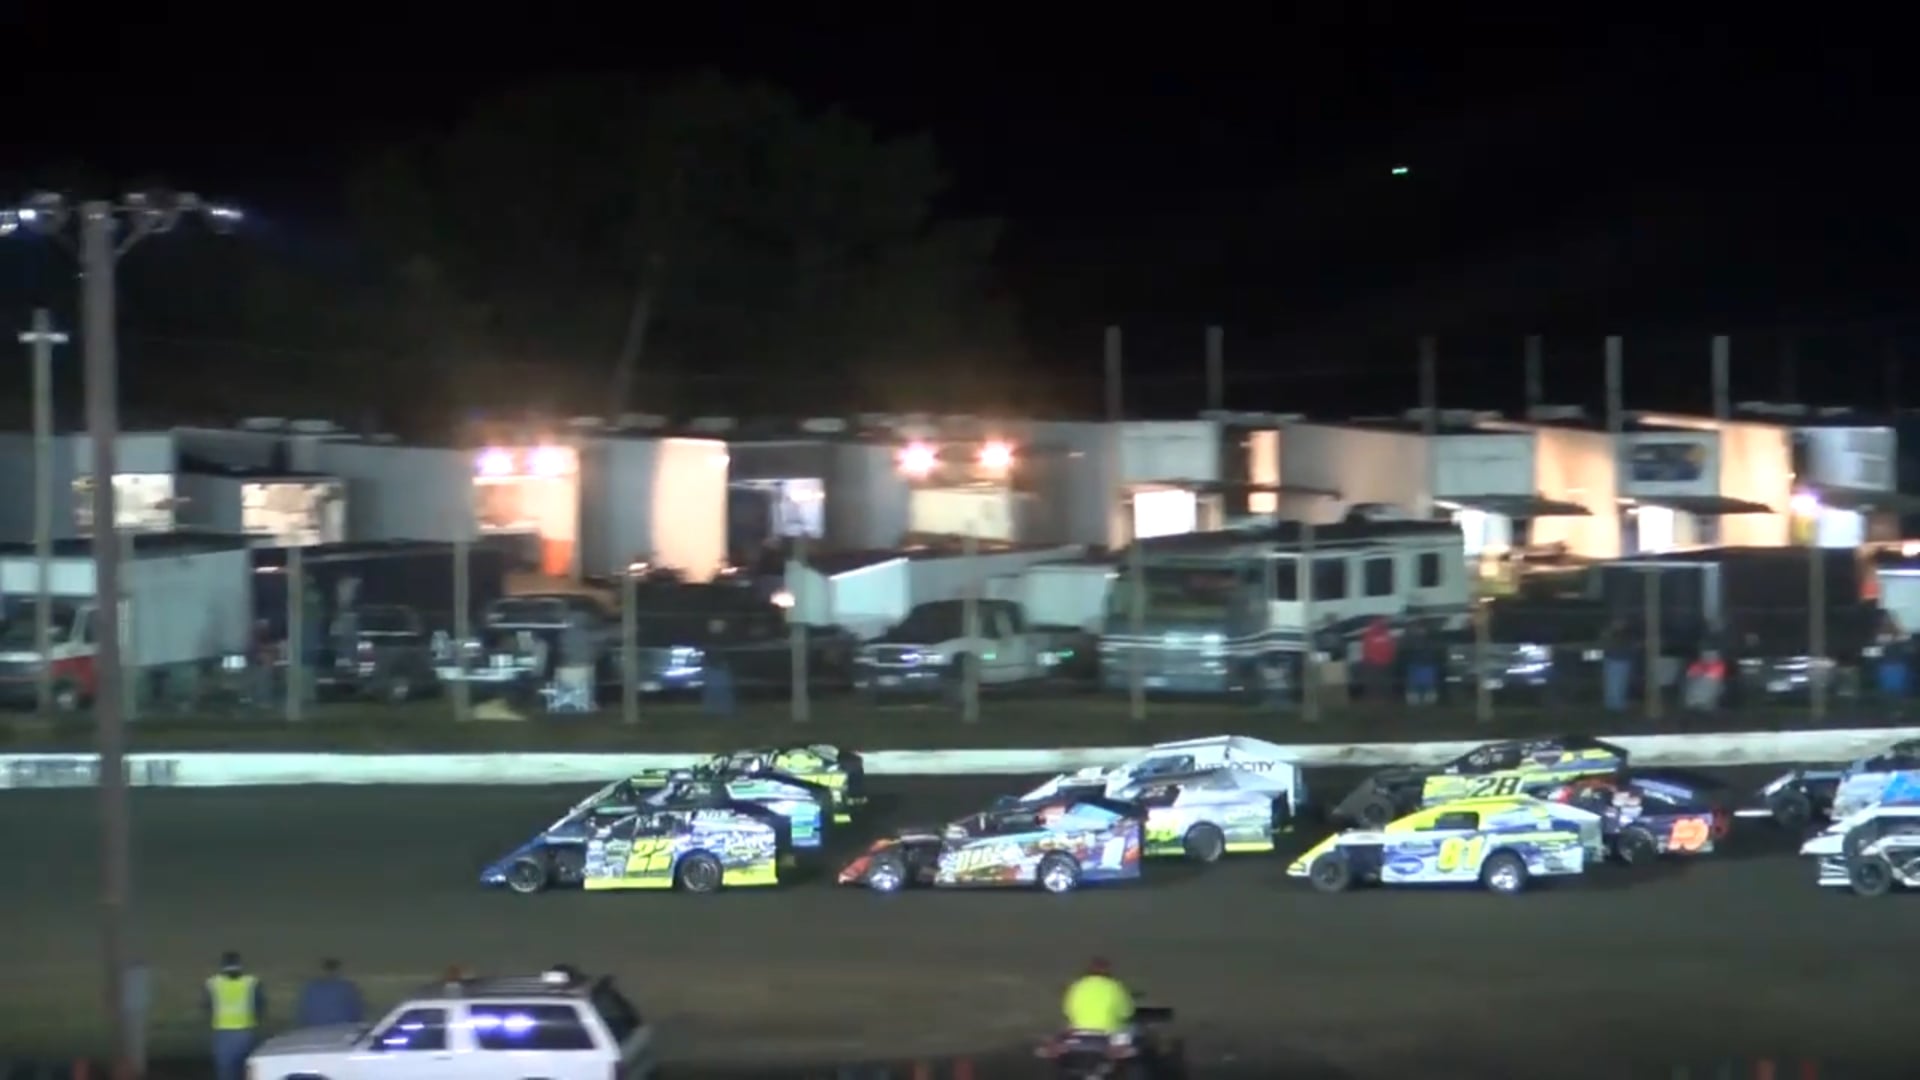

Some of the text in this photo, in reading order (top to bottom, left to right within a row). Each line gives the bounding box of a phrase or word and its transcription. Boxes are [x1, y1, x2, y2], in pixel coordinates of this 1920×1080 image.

[1470, 776, 1521, 797] 28
[626, 837, 674, 874] 22
[1100, 836, 1126, 870] 1
